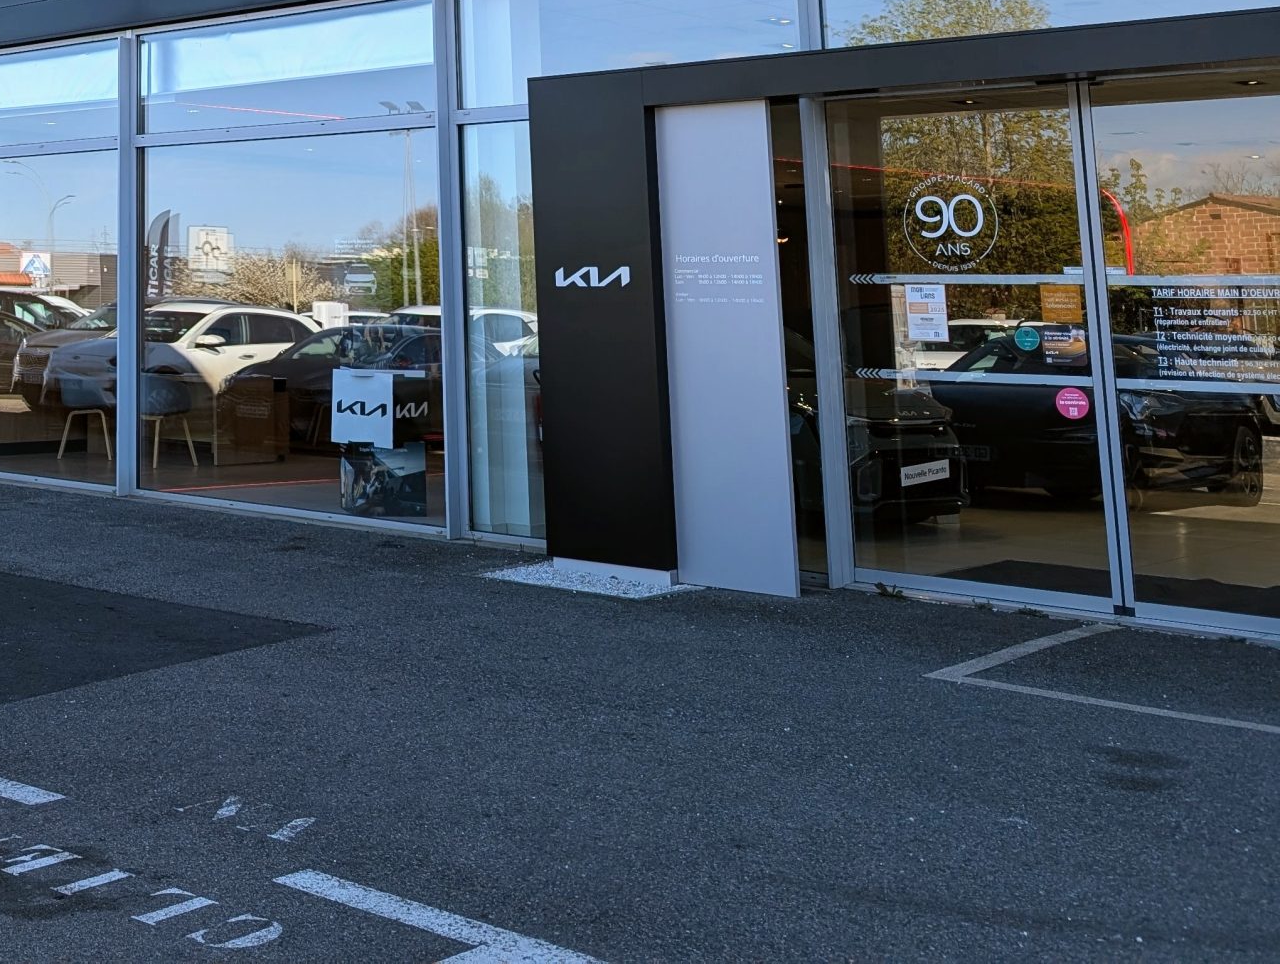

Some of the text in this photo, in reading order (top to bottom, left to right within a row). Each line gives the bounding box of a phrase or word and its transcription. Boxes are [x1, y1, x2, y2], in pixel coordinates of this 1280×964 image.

[909, 174, 986, 198] GROUPE MACARD
[915, 194, 984, 238] 90
[935, 243, 971, 256] ANS
[675, 254, 760, 263] Horaires d'ouverture
[932, 261, 959, 272] DEPUIS
[555, 266, 630, 288] KIA
[1152, 288, 1175, 297] TARIF
[1177, 288, 1215, 297] HORAIRE
[1217, 288, 1239, 297] MAIN
[1153, 307, 1163, 315] T1
[1169, 307, 1201, 316] Travaux
[1203, 308, 1239, 316] courants
[1154, 318, 1189, 327] (réparation
[1156, 331, 1166, 340] T2
[1172, 331, 1213, 340] Technicité
[1215, 334, 1253, 343] moyenne
[1193, 344, 1221, 354] échange
[1222, 345, 1238, 354] joint
[1239, 345, 1248, 353] de
[1158, 356, 1168, 365] T3
[1174, 356, 1198, 366] Haute
[1199, 357, 1239, 367] technicité
[1159, 368, 1187, 377] (révision
[1196, 369, 1225, 378] réfection
[336, 399, 387, 417] KIA
[395, 401, 429, 419] KIA
[904, 469, 927, 480] Nouvelle
